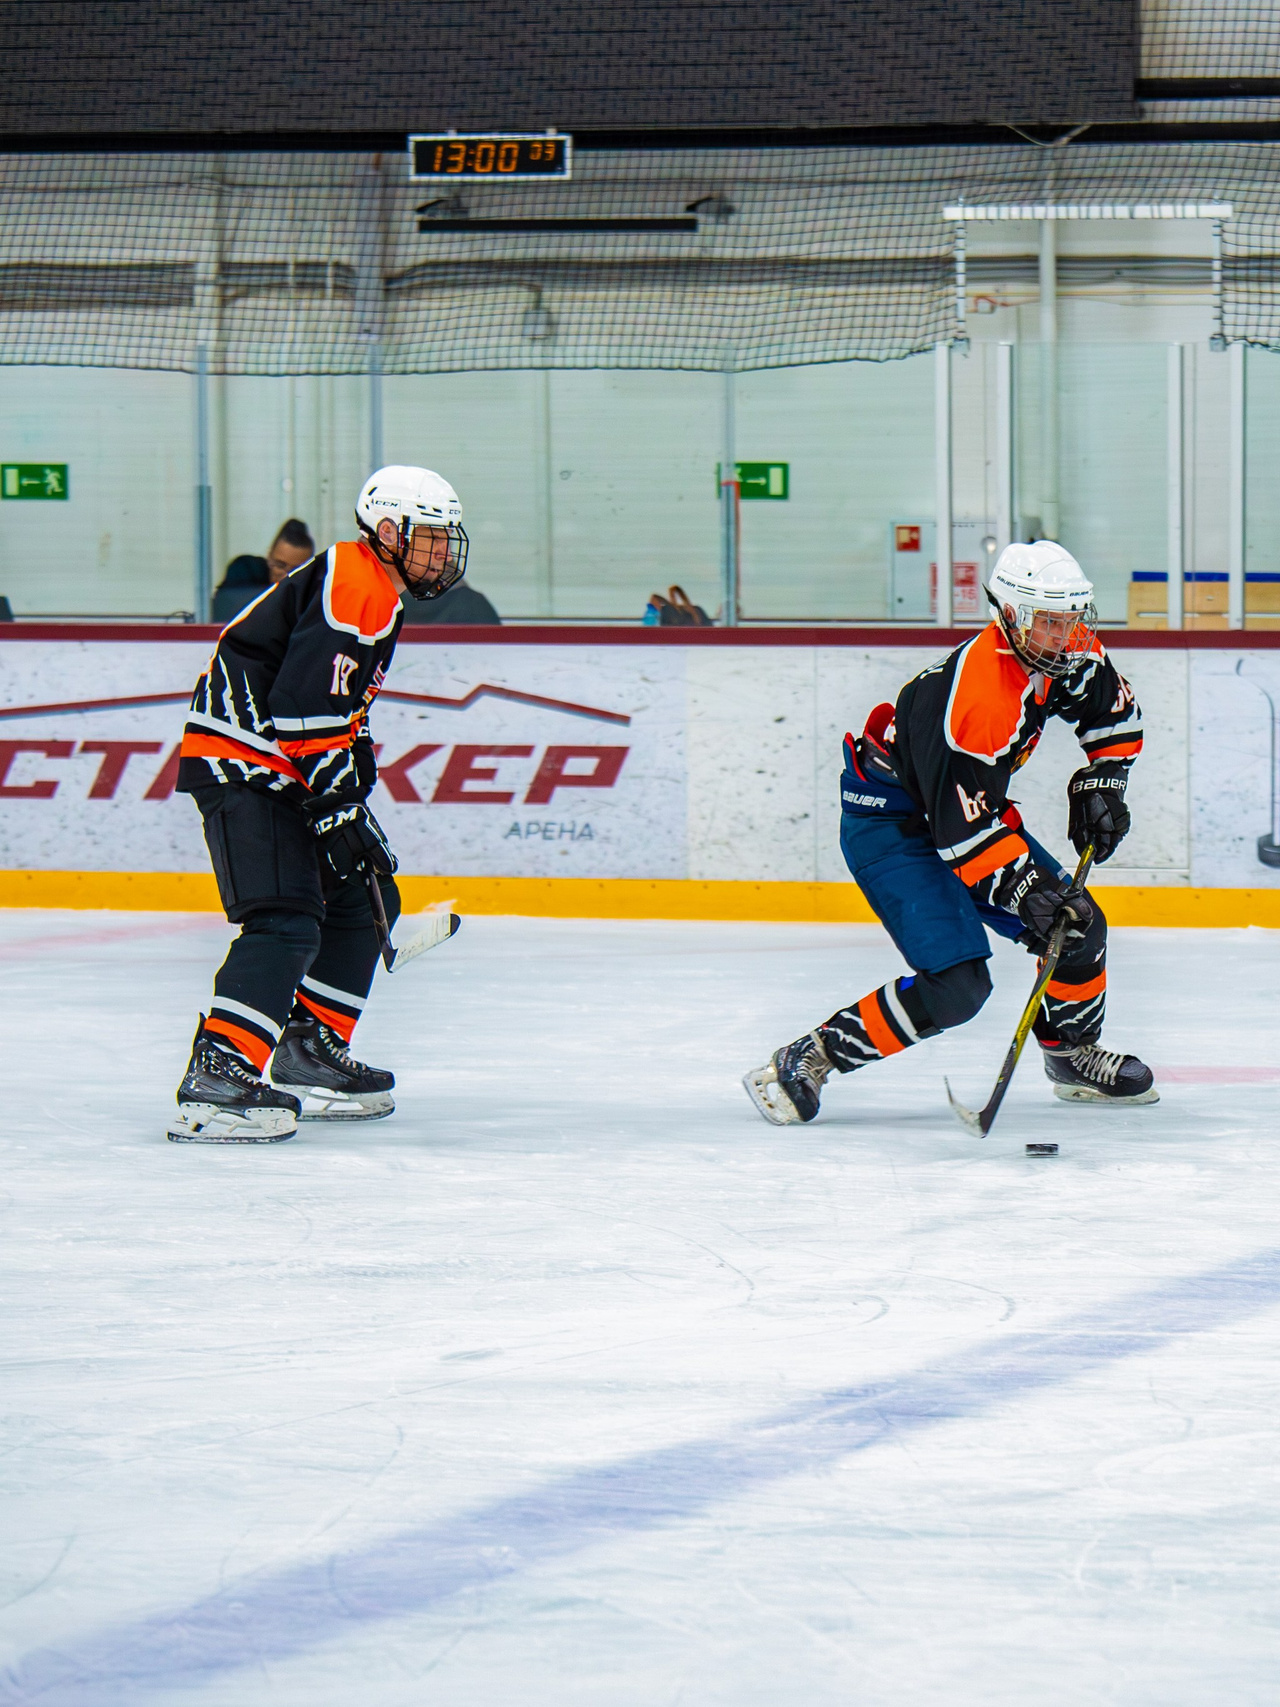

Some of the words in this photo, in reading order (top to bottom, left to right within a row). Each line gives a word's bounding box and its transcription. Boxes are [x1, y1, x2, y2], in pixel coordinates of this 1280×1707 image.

[433, 142, 519, 173] 13:00
[0, 740, 630, 805] СТКЕР
[503, 820, 594, 840] АРЕНА
